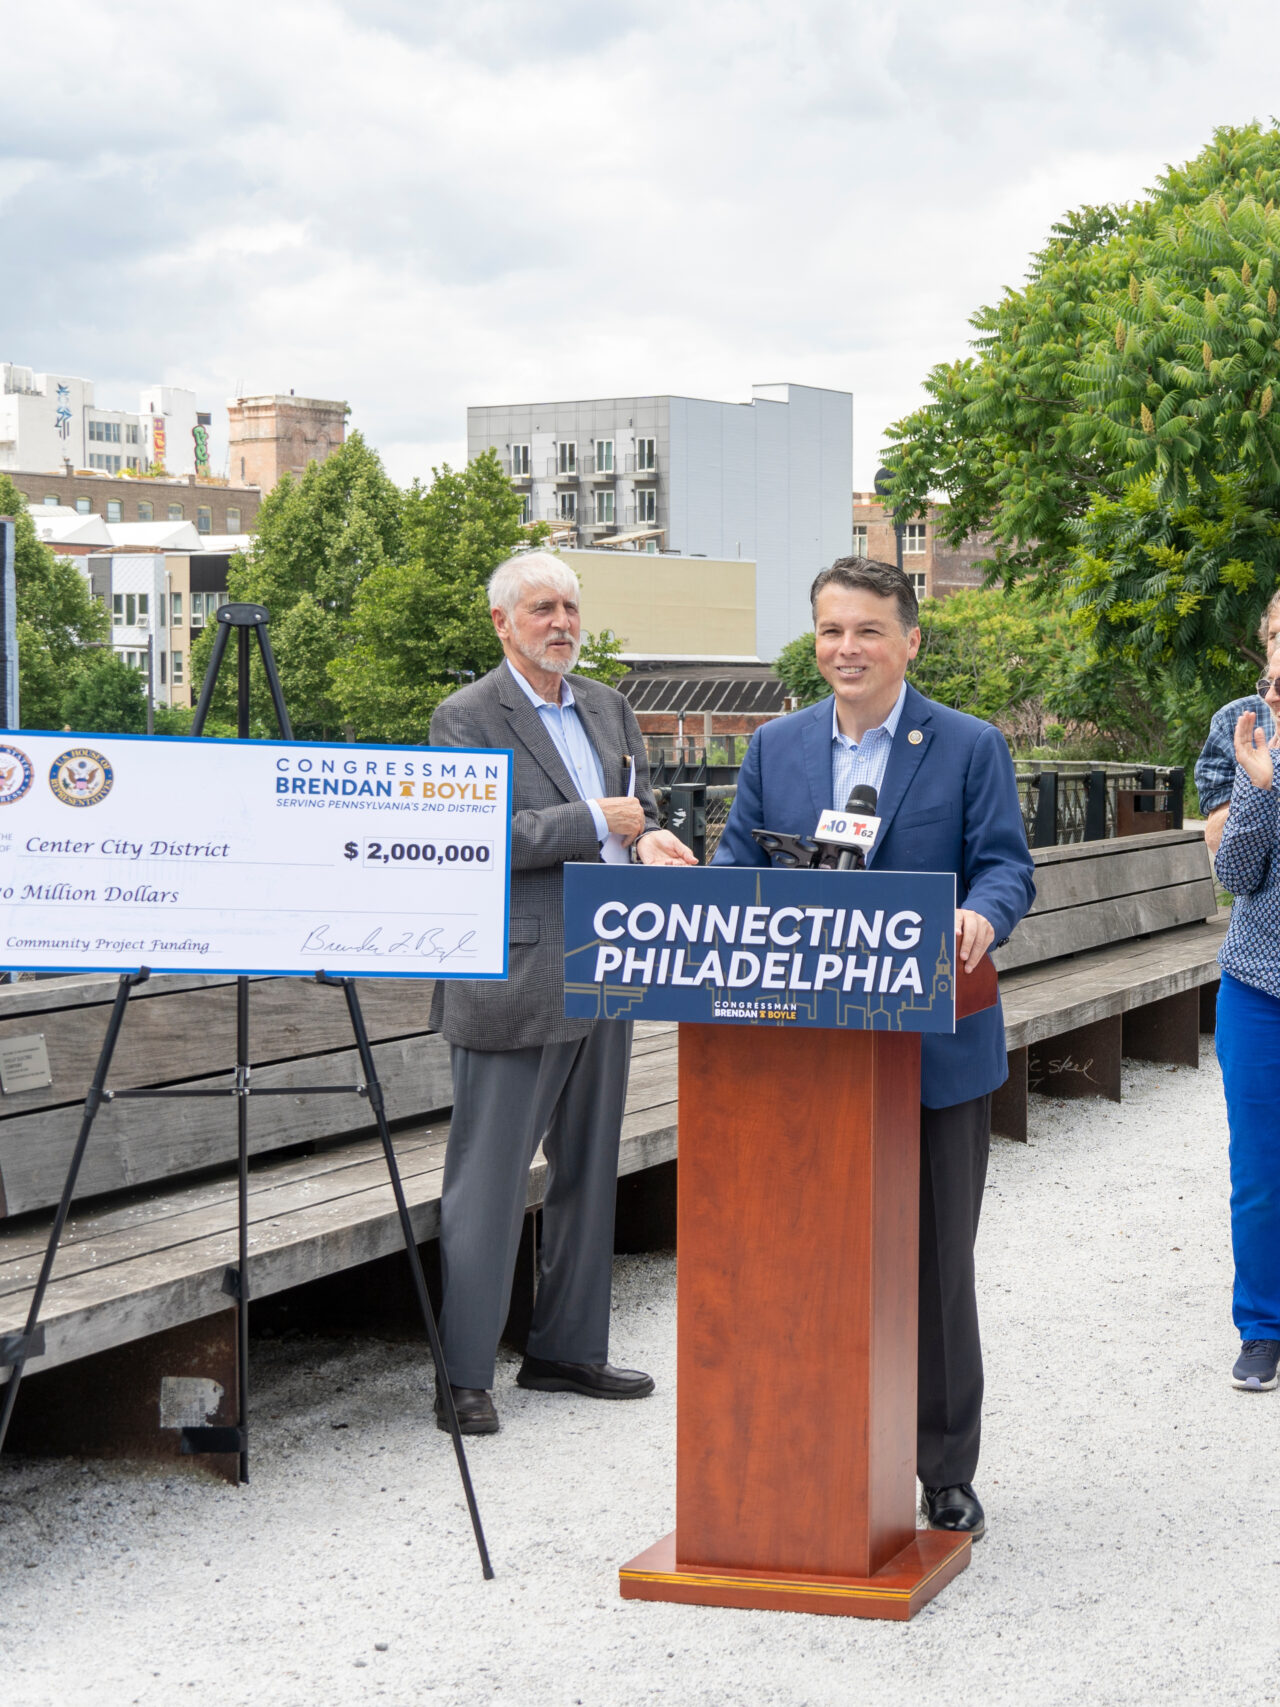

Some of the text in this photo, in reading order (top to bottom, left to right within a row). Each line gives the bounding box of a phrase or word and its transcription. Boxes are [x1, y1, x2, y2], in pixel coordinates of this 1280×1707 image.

[276, 758, 498, 779] CONGRESSMAN
[276, 777, 497, 800] BRENDAN BOYLE
[276, 799, 497, 814] SERVING PENNSYLVANIA'S 2ND DISTRICT
[830, 820, 847, 833] 10
[861, 830, 873, 838] 62
[26, 837, 230, 860] Center City District
[344, 841, 490, 865] $ 2,000,000
[21, 883, 96, 901] Million
[105, 885, 179, 902] Dollars
[593, 901, 922, 950] CONNECTING
[6, 937, 210, 954] Community Project Funding
[594, 947, 924, 994] PHILADELPHIA
[714, 1001, 797, 1011] CONGRESSMAN
[714, 1009, 797, 1020] BRENDAN BOYLE
